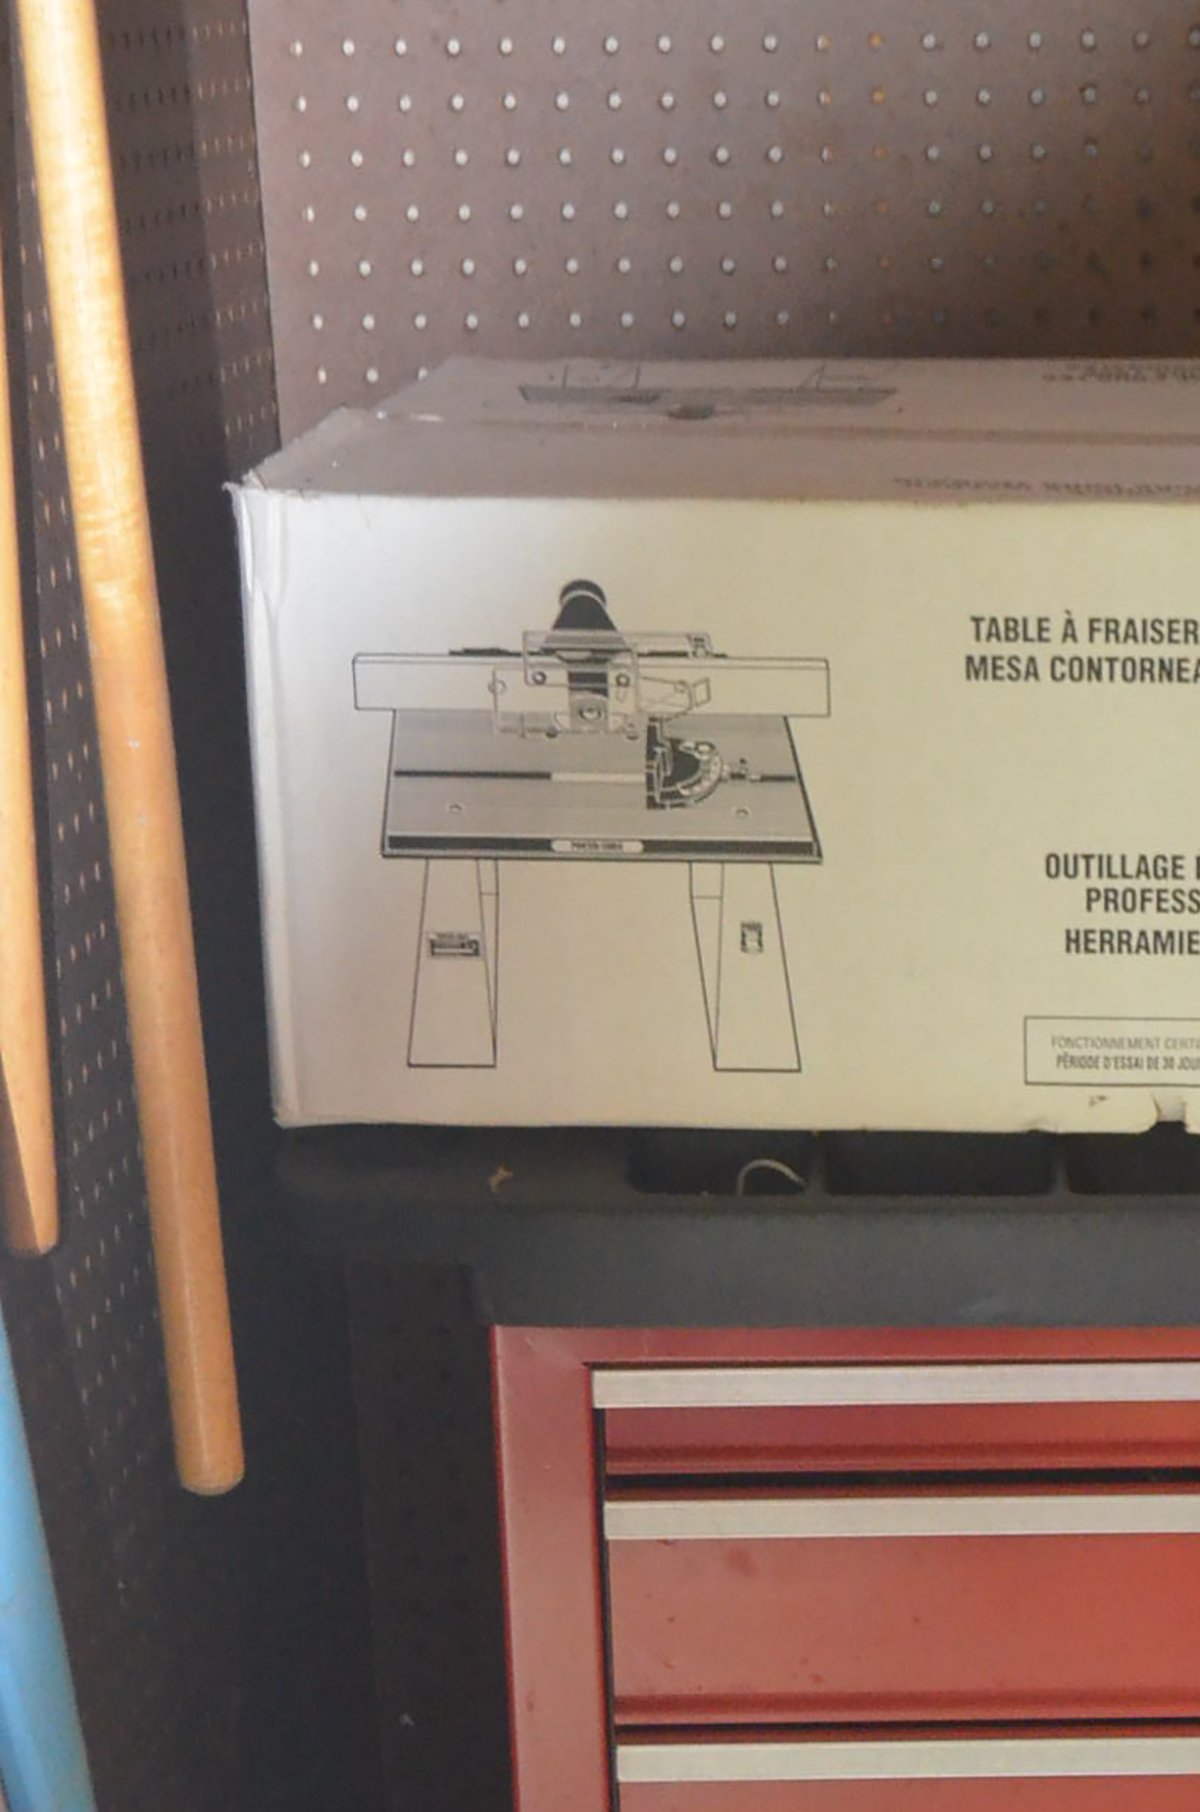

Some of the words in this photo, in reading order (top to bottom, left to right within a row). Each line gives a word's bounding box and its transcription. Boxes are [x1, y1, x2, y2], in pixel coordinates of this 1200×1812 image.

[970, 615, 1051, 643] TABLE
[1061, 609, 1079, 644] À
[1088, 617, 1200, 645] FRAISER
[965, 654, 1040, 682] MESA
[1045, 852, 1185, 881] OUTILLAGE
[1147, 1056, 1160, 1070] DE
